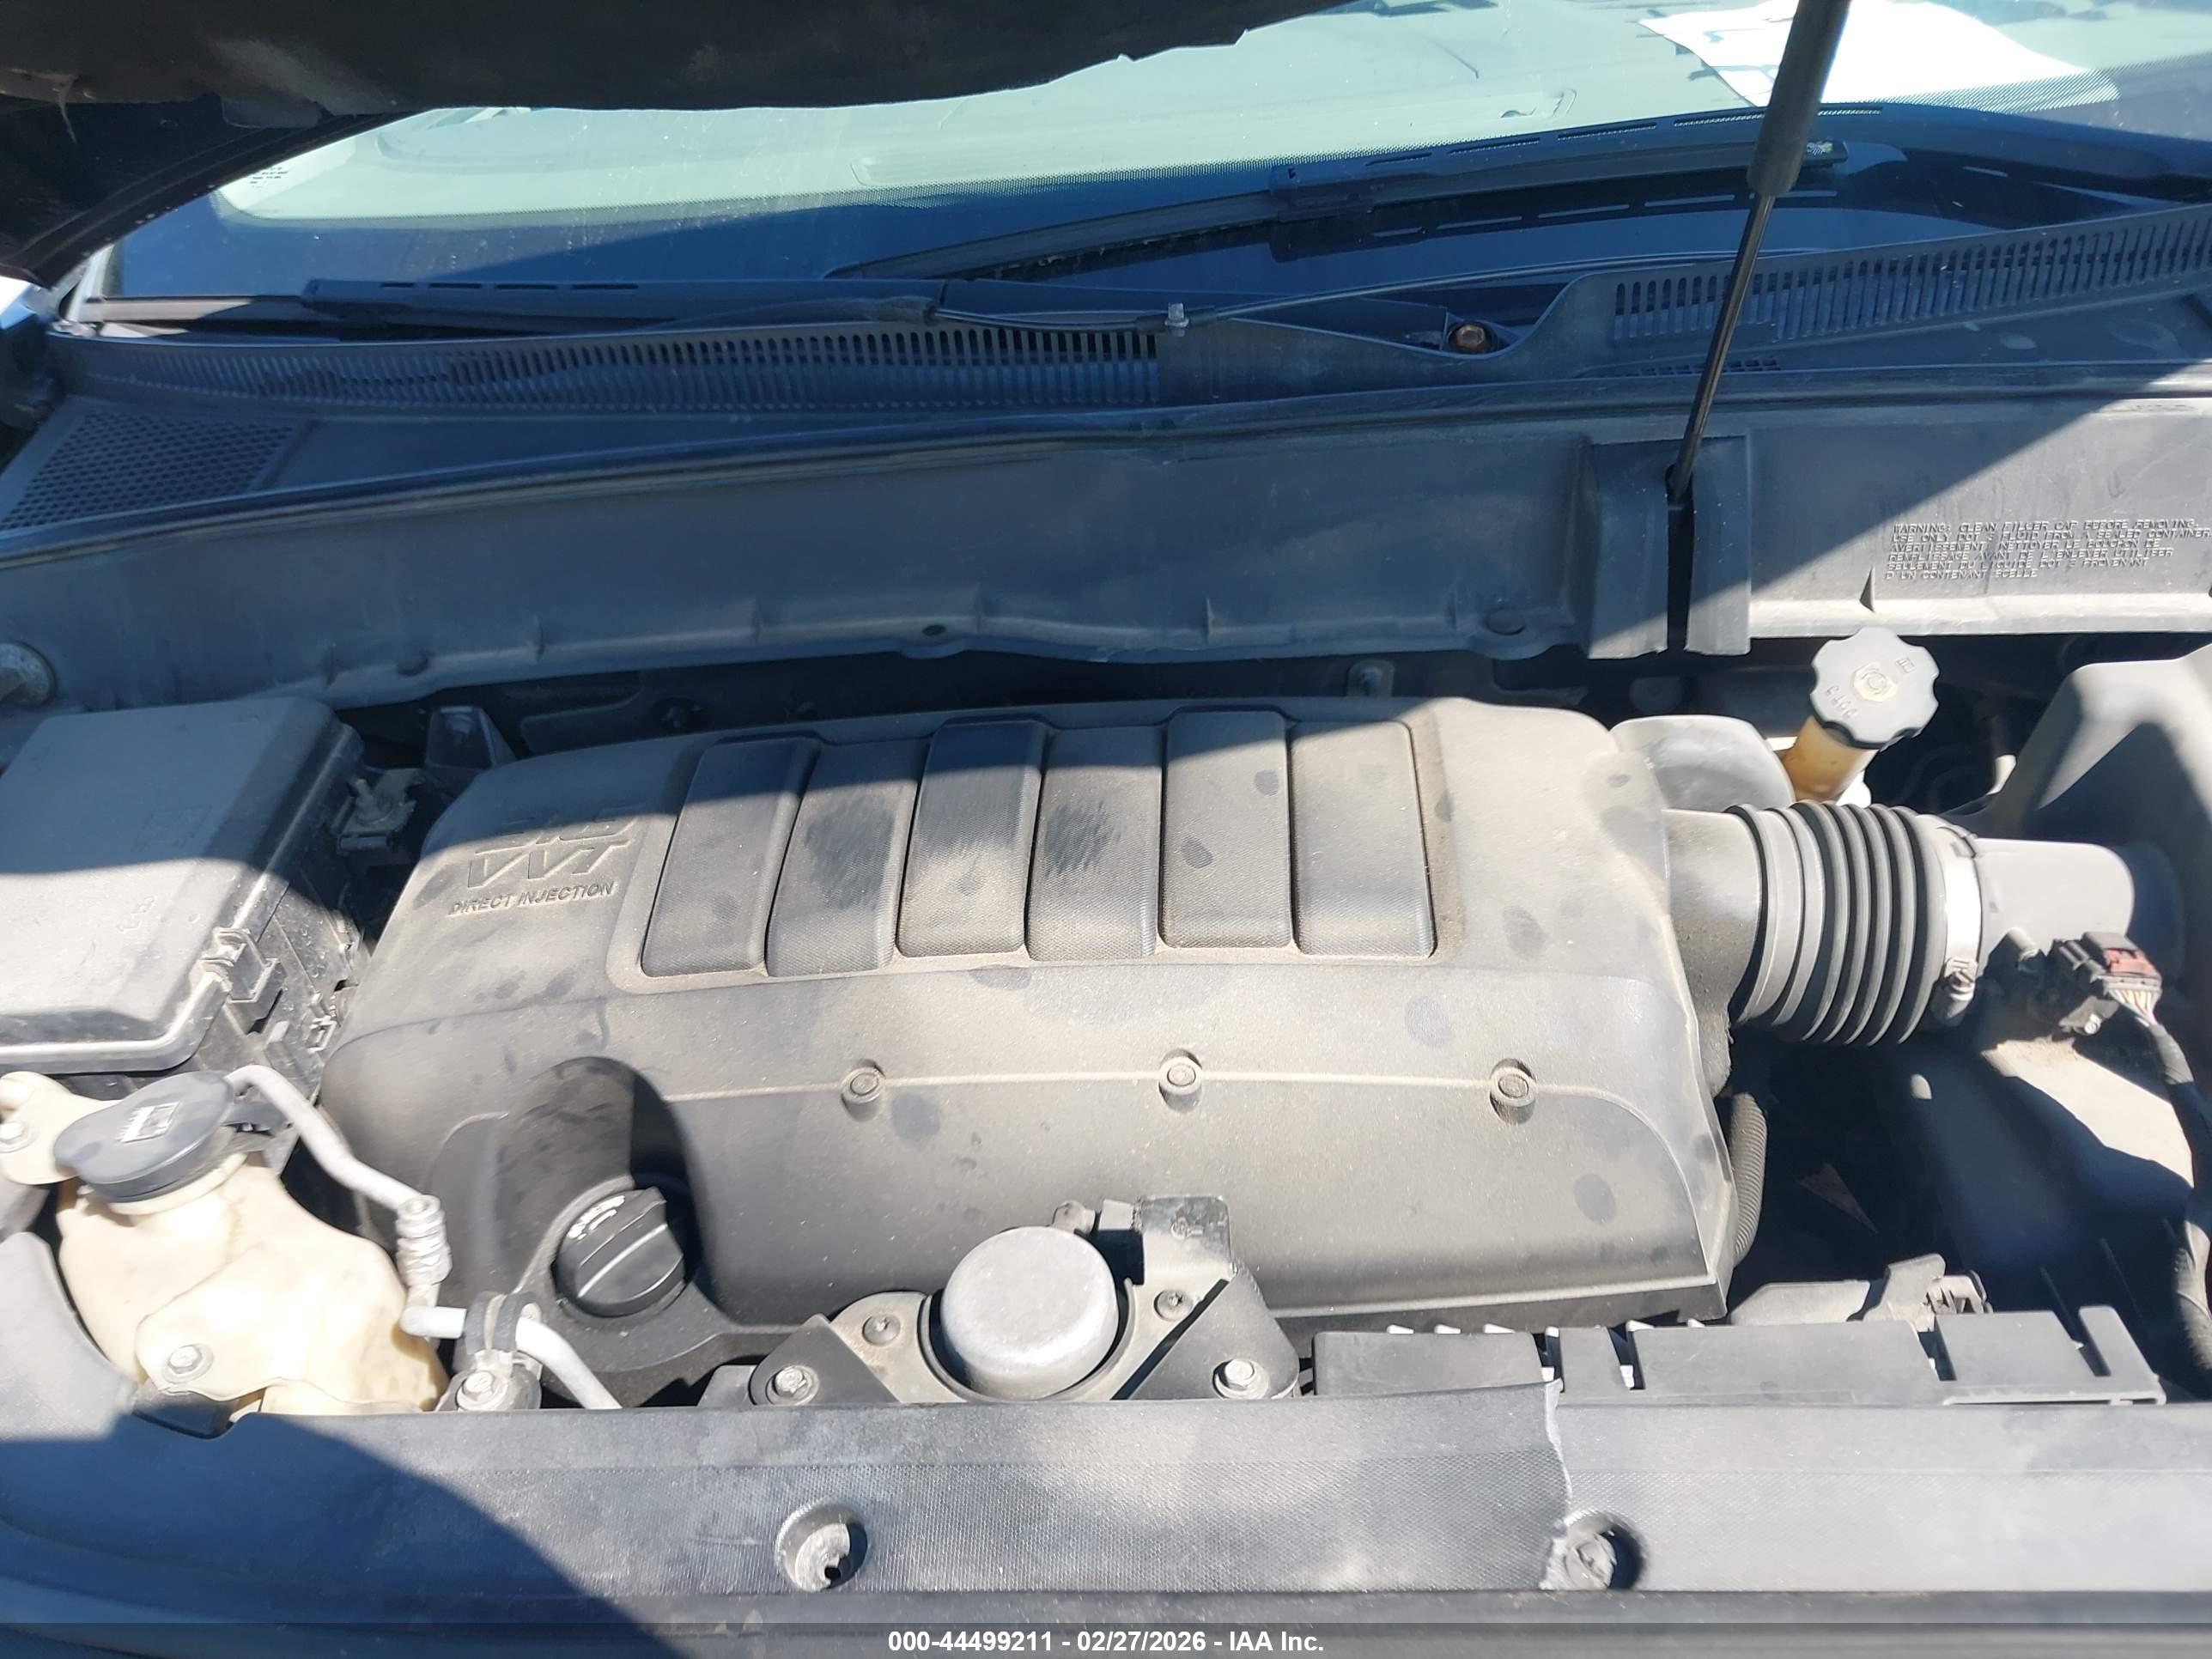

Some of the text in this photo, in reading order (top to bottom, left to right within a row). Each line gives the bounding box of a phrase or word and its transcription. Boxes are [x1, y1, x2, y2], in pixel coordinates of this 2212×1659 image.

[1893, 523, 1950, 533] WARNING:
[1958, 522, 1996, 532] CLEAN
[2002, 521, 2049, 532] FILLER
[2054, 520, 2078, 530] CAP
[2083, 520, 2130, 530] BEFORE
[1892, 532, 1914, 542] USE
[1920, 532, 1950, 542] ONLY
[1957, 532, 1980, 541] DOT
[2001, 532, 2040, 541] FLUID
[2045, 531, 2075, 540] FROM
[2097, 529, 2142, 538] SEALED
[1998, 540, 2059, 550] NETTOYER
[2064, 540, 2081, 550] LE
[2144, 538, 2160, 549] DE
[1888, 551, 1970, 562] REMPLISSAGE
[1974, 550, 2011, 561] AVANT
[2018, 550, 2033, 560] DE
[2113, 548, 2173, 557] UTILISER
[1887, 561, 1953, 570] SEULEMENT
[1959, 561, 1976, 569] DU
[2039, 559, 2062, 568] DOT
[2082, 557, 2149, 568] PROVENANT
[1922, 569, 1986, 580] CONTENANT
[1995, 568, 2039, 578] SCELLE
[467, 838, 632, 889] VVT
[447, 881, 617, 917] DIRECT INJECTION
